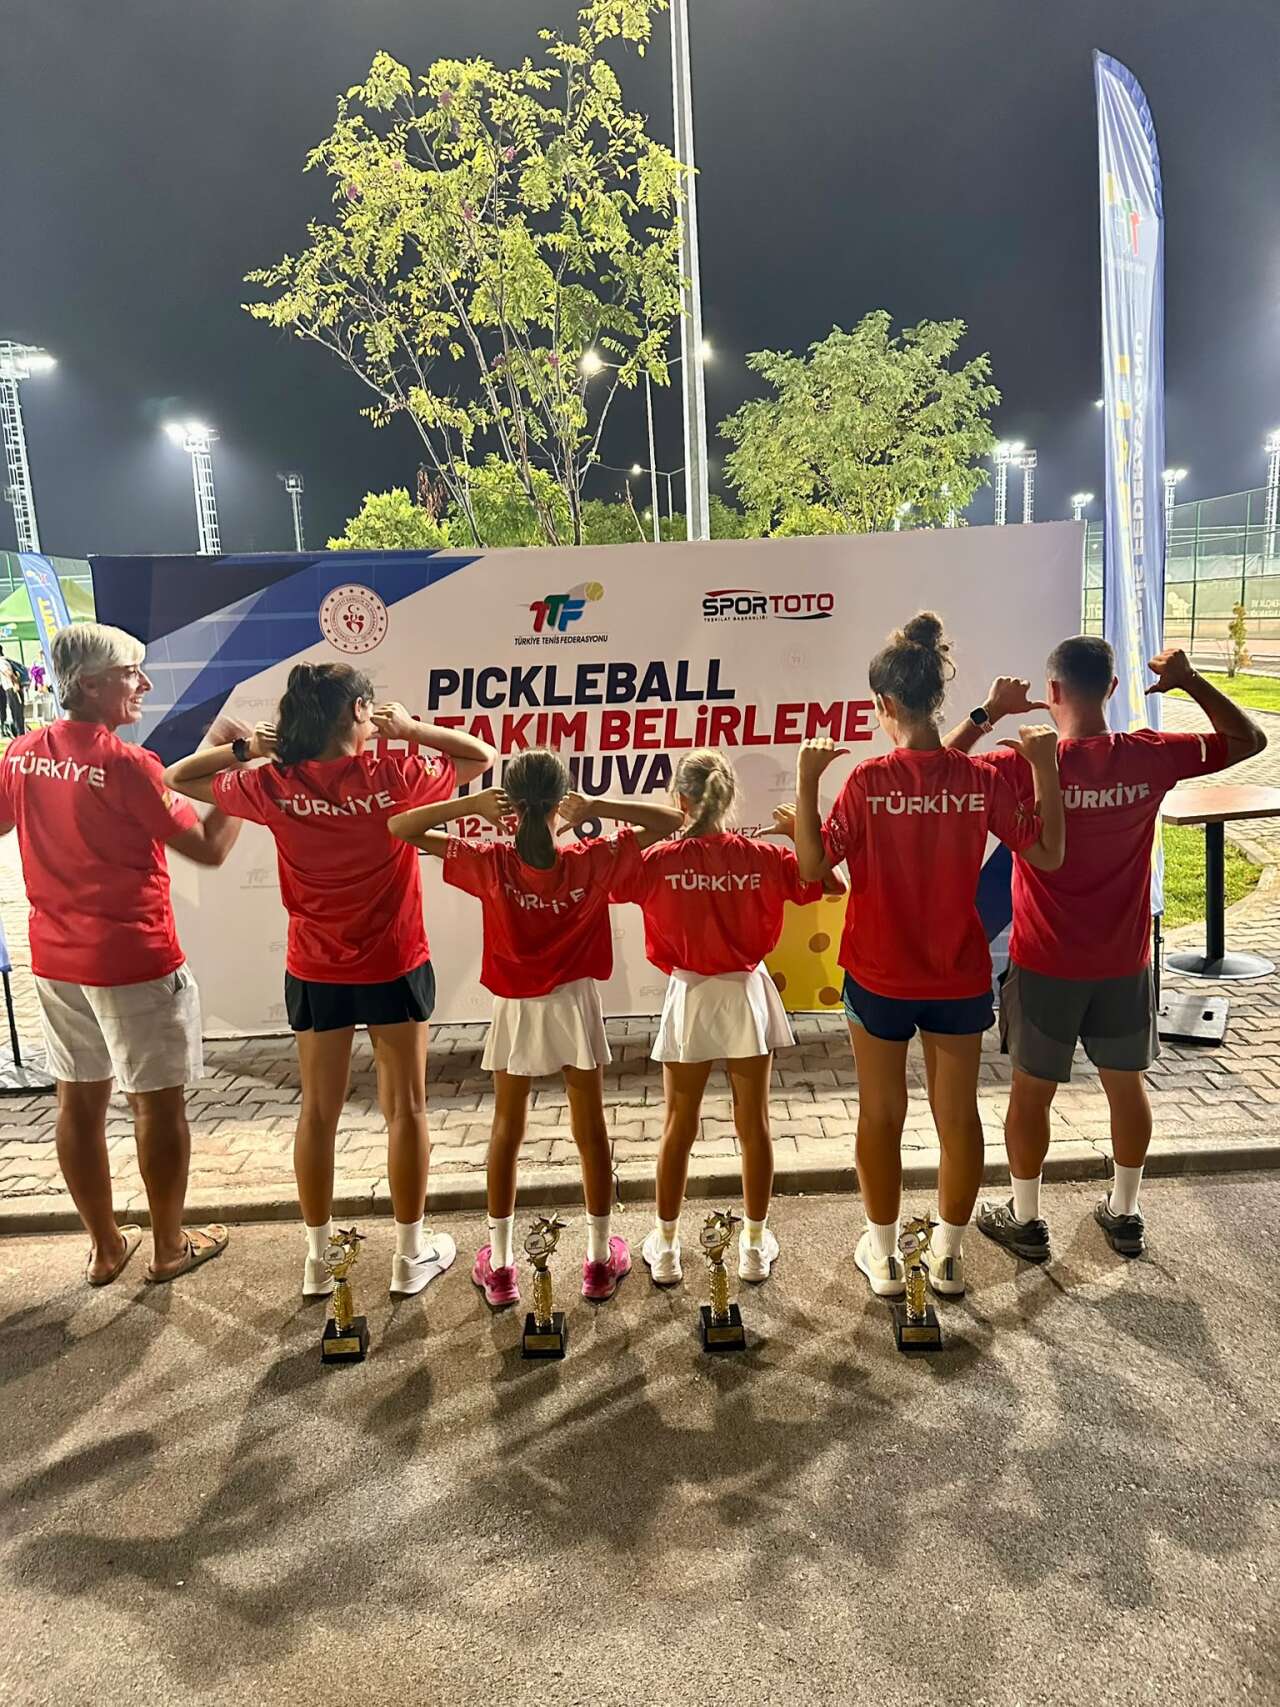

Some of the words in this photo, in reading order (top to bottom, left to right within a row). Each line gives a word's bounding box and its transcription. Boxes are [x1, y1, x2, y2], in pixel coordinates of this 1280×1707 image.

[529, 594, 586, 633] TTF
[514, 635, 541, 646] TÜRKİYE
[542, 634, 560, 645] TENİS
[560, 633, 609, 644] FEDERASYONU
[427, 658, 736, 711] PICKLEBALL
[599, 700, 876, 751] BELİRLEME
[9, 750, 106, 788] TÜRKİYE
[866, 787, 985, 816] TÜRKİYE
[1060, 781, 1151, 809] ÜRKİYE
[665, 869, 761, 893] TÜRKİYE
